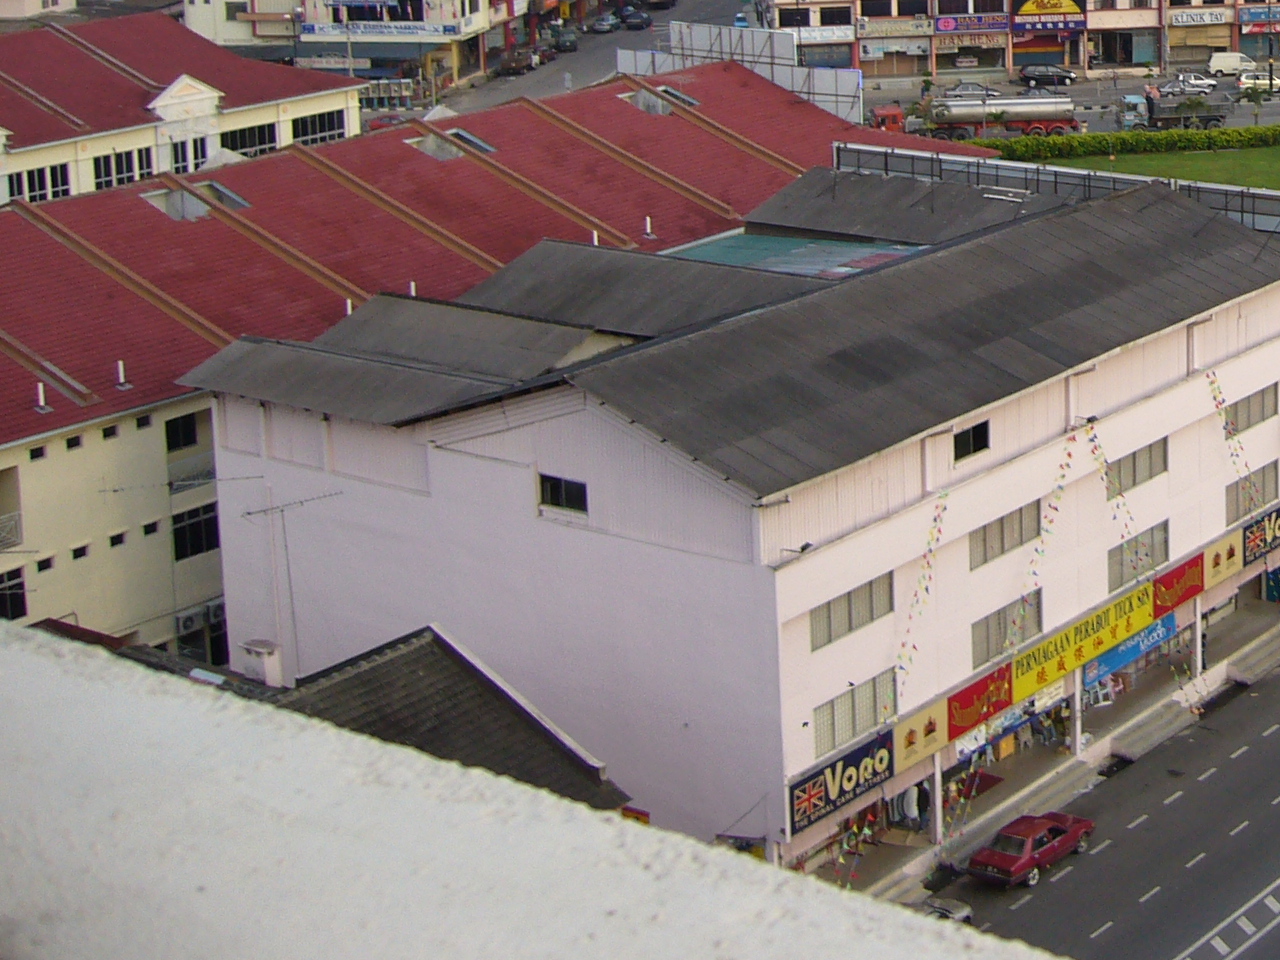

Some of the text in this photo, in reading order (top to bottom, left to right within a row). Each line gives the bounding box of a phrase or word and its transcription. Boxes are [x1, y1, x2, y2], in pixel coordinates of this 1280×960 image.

[1173, 11, 1225, 24] KLINIK TAY
[940, 34, 965, 46] HAN
[1015, 628, 1071, 680] PERNIAGAAN
[1073, 607, 1111, 645] PERABOT
[1114, 594, 1135, 621] TECK
[824, 748, 890, 801] Vono
